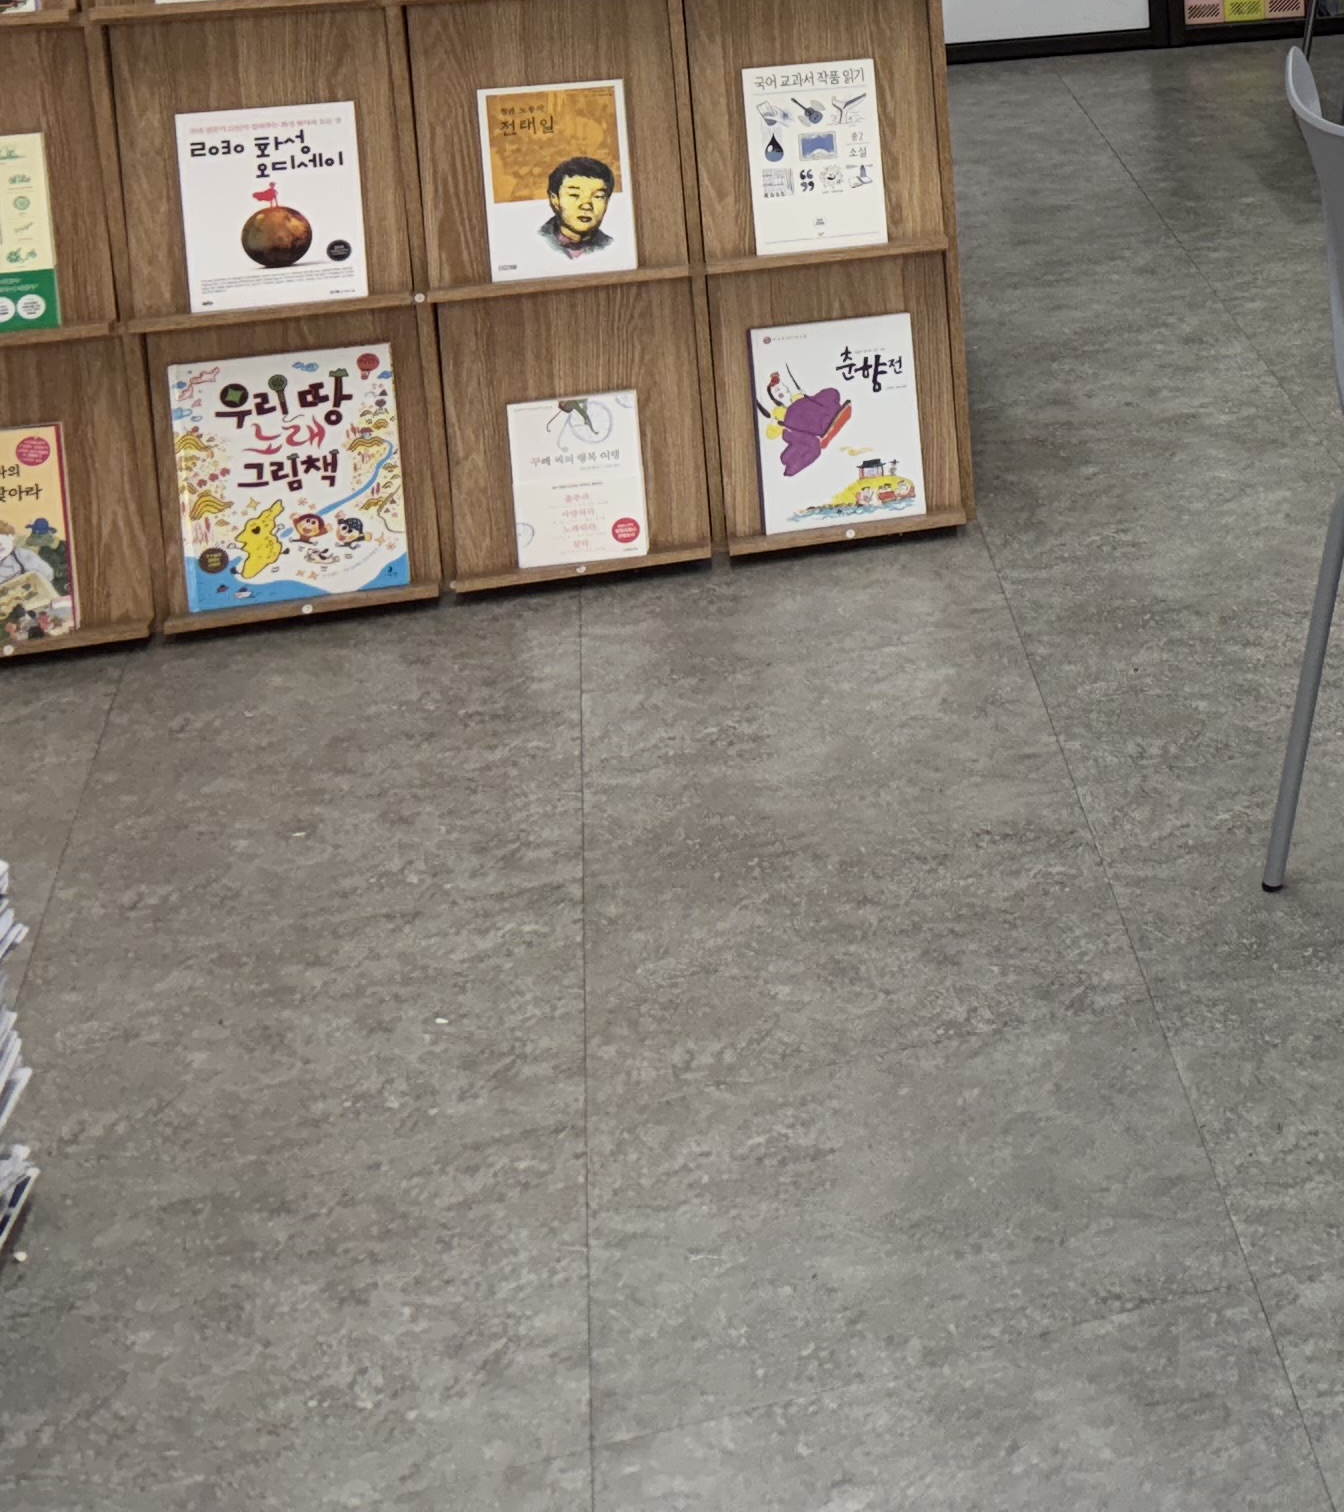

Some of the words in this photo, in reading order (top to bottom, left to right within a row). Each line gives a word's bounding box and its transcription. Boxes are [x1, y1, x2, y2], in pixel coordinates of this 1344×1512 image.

[754, 73, 777, 90] 국어
[779, 72, 815, 88] 교과서
[817, 70, 840, 85] 작품
[842, 67, 865, 84] 읽기
[500, 115, 555, 137] 전태일
[253, 129, 311, 159] 화성
[849, 146, 867, 159] 소설
[255, 151, 344, 179] 오디세이
[836, 345, 903, 393] 춘향전
[214, 374, 290, 429] 우리
[297, 368, 353, 426] 땅
[243, 414, 326, 455] 노래
[600, 449, 620, 460] 여행
[237, 449, 340, 492] 그림책
